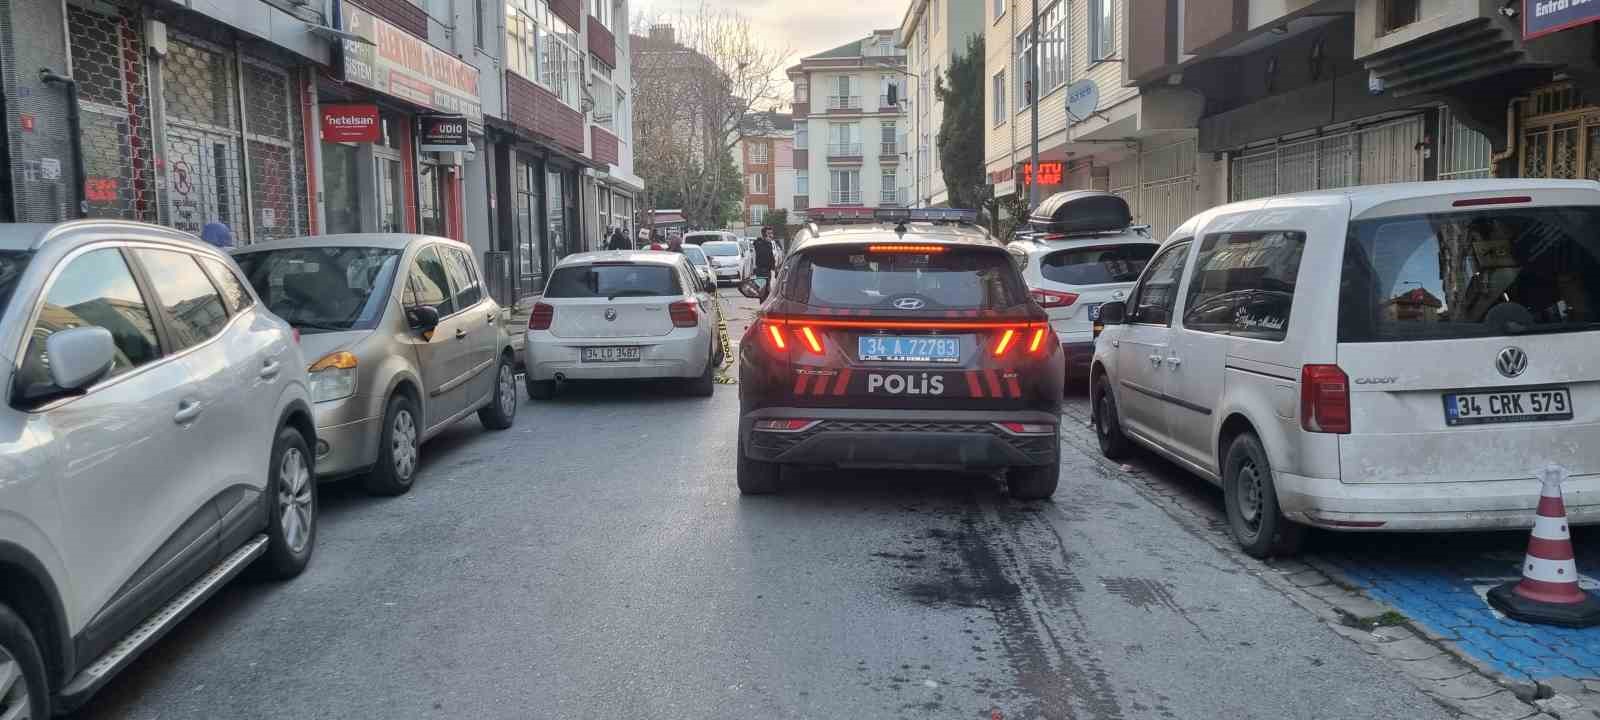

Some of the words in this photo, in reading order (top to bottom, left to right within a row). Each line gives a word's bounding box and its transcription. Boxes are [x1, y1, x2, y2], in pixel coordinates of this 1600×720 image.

[868, 339, 885, 354] 34
[895, 339, 902, 354] A
[1458, 396, 1481, 416] 34
[1488, 393, 1523, 414] CRK
[1530, 392, 1564, 412] 579
